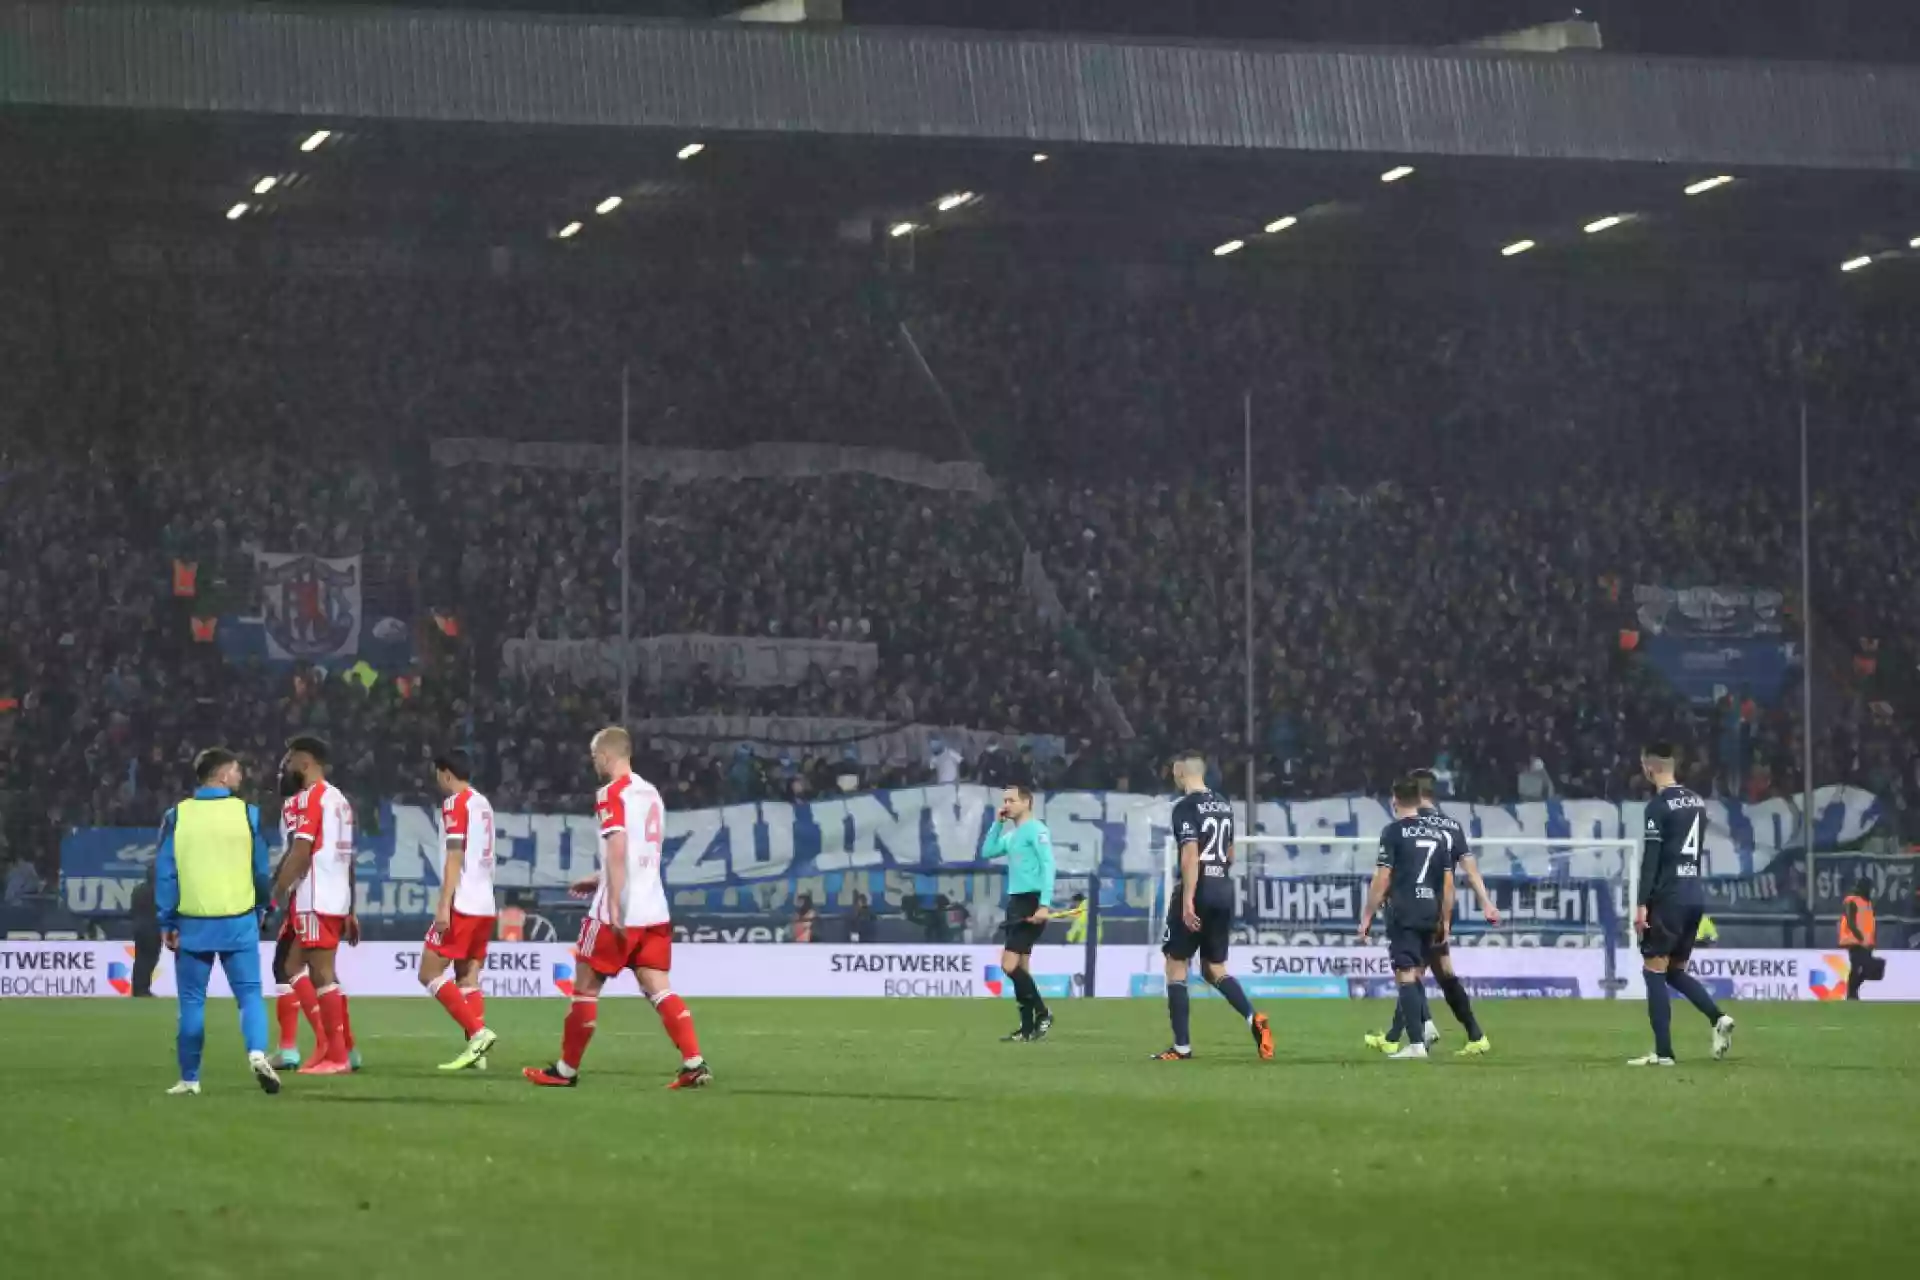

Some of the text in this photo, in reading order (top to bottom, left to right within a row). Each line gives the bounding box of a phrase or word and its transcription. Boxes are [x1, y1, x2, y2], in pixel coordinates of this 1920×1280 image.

[662, 800, 794, 884] ZU
[1200, 816, 1232, 863] 20
[1680, 811, 1700, 861] 4
[1415, 839, 1437, 884] 7
[395, 952, 541, 970] STERKE
[831, 954, 972, 972] STADTWERKE
[1251, 955, 1391, 975] STADTWERKE
[1686, 959, 1798, 978] ADTWERKE
[1, 976, 96, 995] BOCHUM
[480, 978, 541, 996] CHUM
[884, 979, 972, 998] BOCHUM
